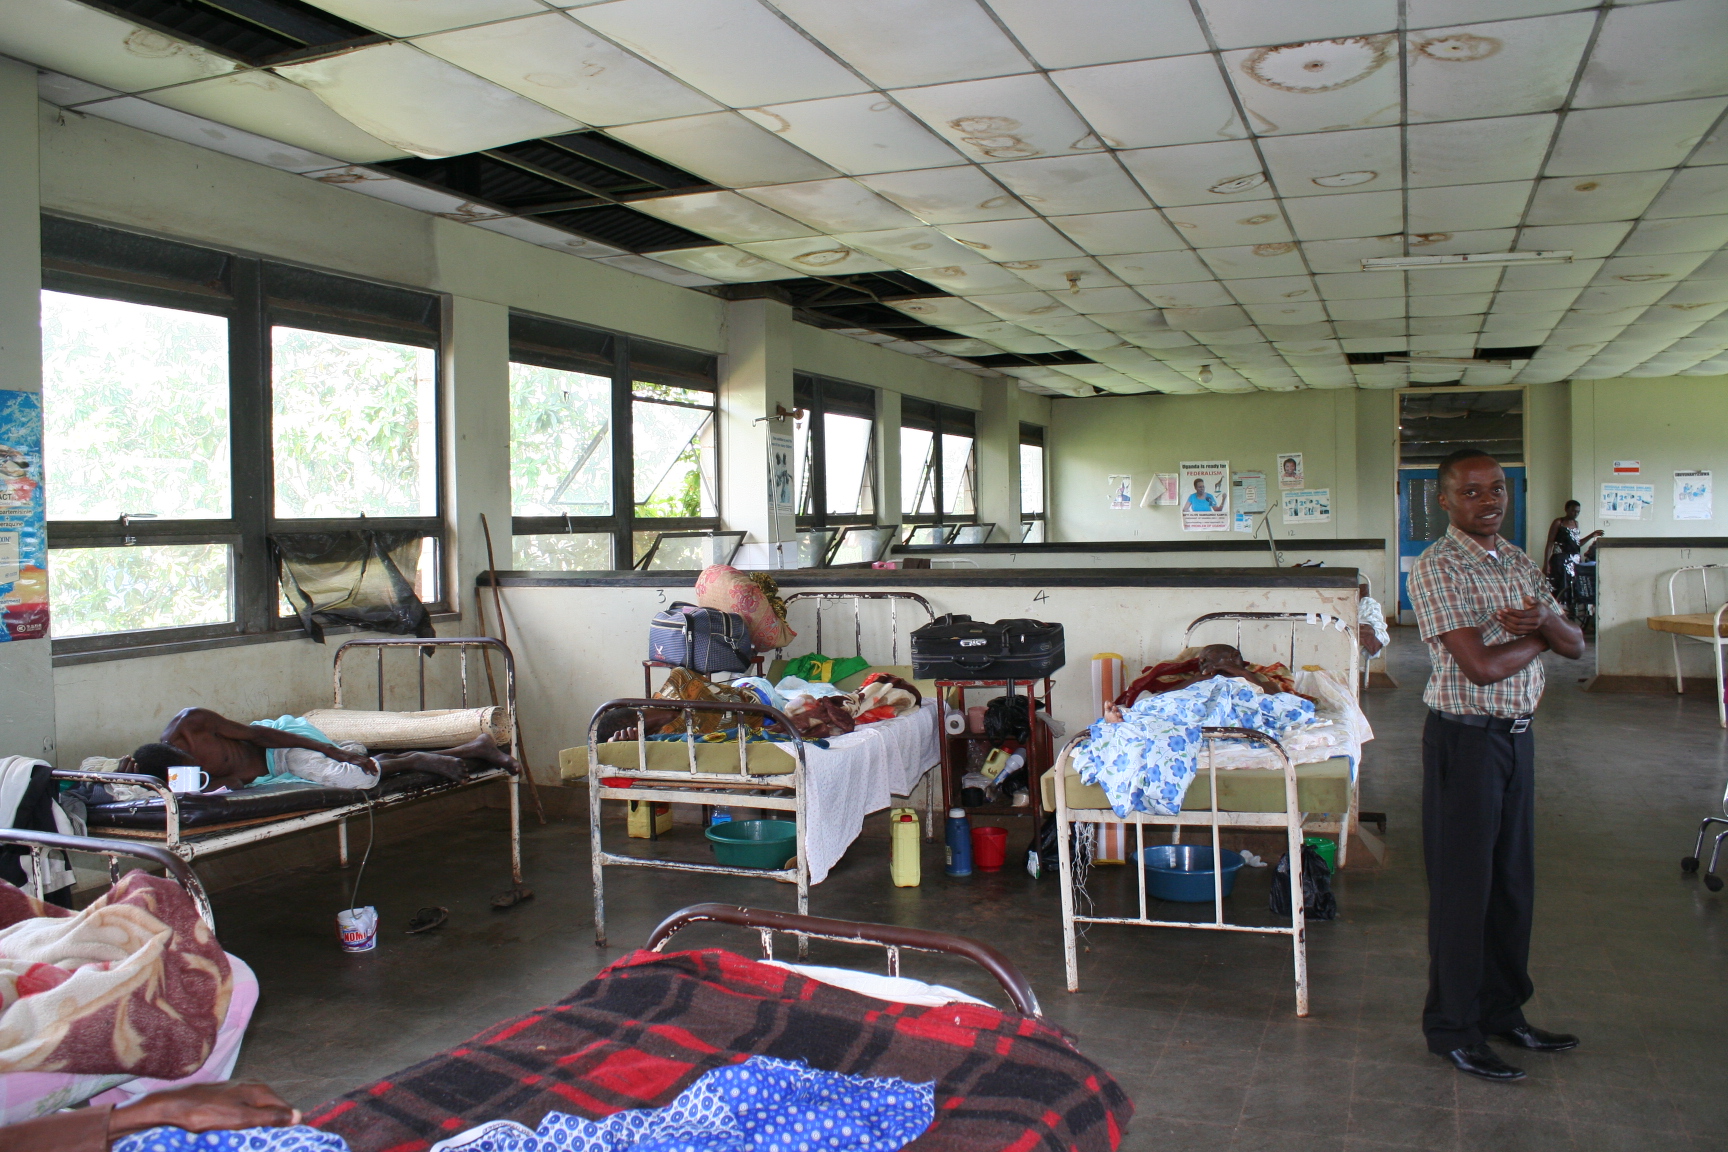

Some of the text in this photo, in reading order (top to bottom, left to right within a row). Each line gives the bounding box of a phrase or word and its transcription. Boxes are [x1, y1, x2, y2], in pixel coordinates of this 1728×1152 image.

[1010, 553, 1016, 562] 7
[1278, 551, 1285, 564] 8
[1681, 549, 1690, 559] 17
[656, 589, 667, 604] 3
[1033, 589, 1050, 605] 4
